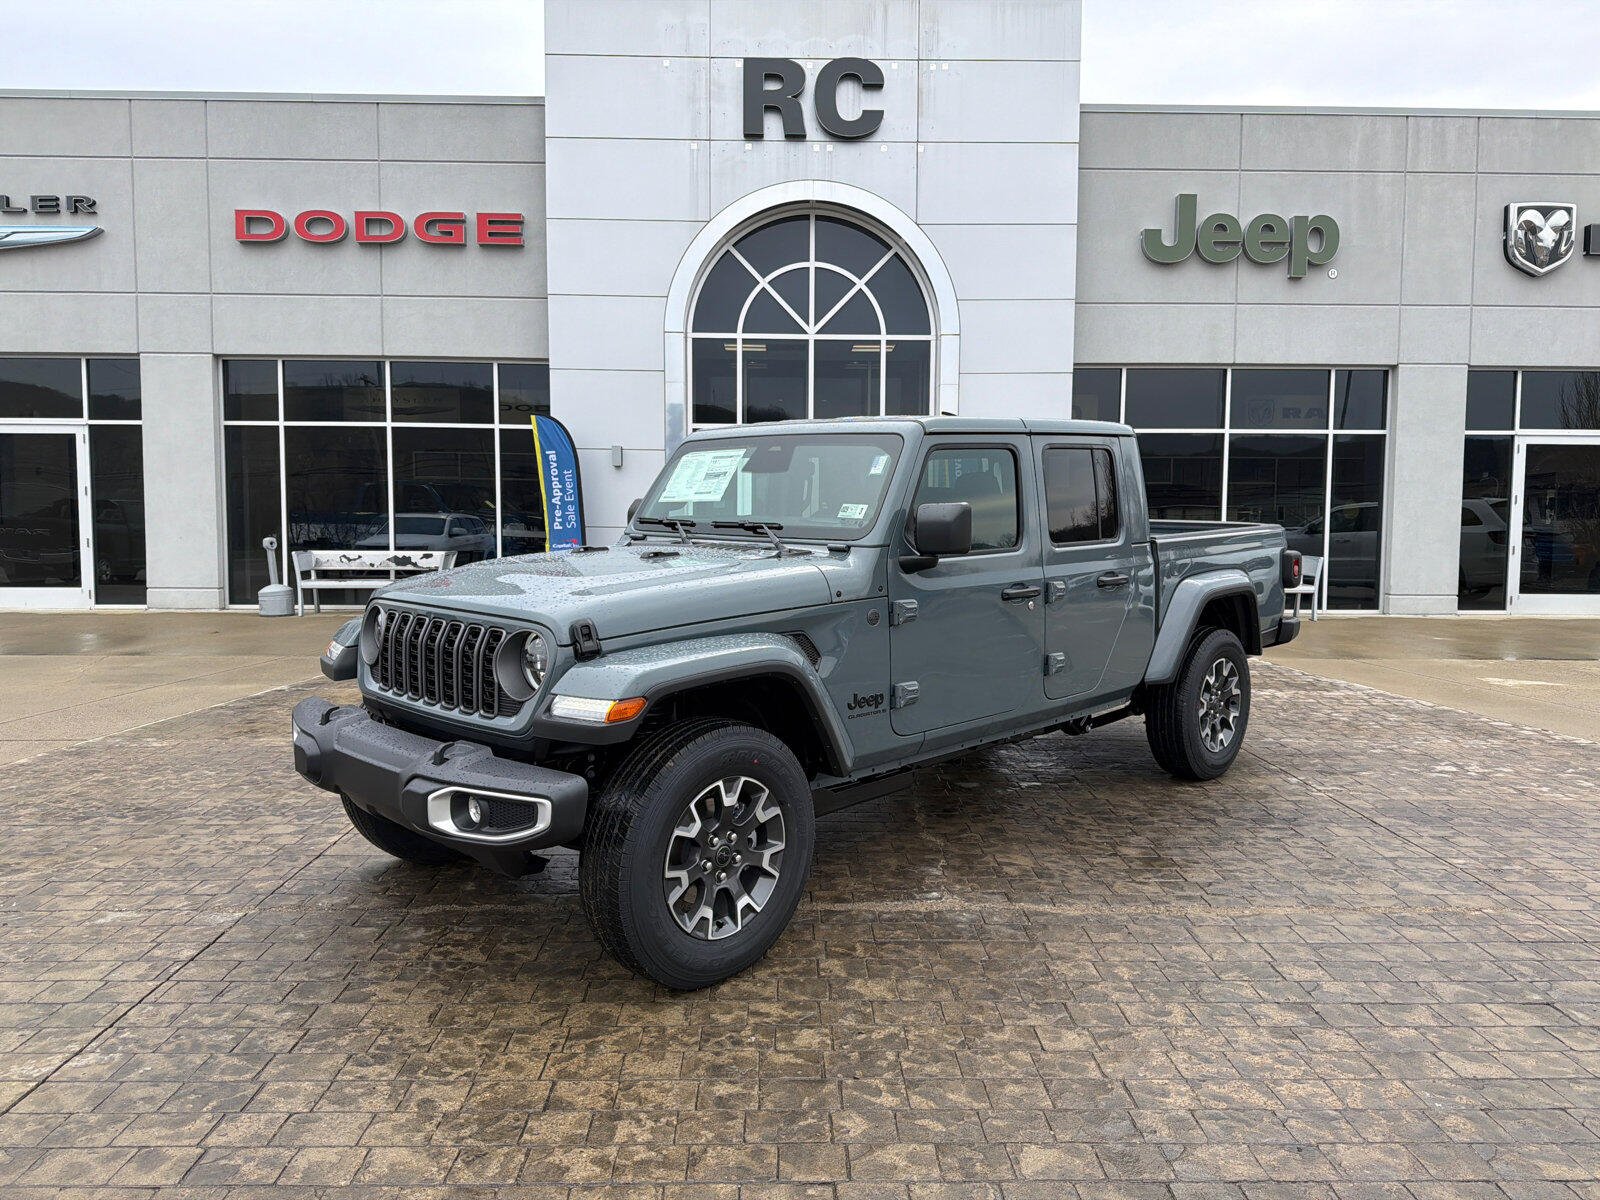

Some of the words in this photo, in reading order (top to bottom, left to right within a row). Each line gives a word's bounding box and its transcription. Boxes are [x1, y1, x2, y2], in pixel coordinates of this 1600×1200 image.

[743, 57, 885, 141] RC
[234, 208, 525, 247] DODGE
[1141, 193, 1340, 279] Jeep
[545, 450, 563, 530] Pre-Approval
[563, 469, 575, 501] Event
[565, 505, 577, 529] Sale
[847, 693, 884, 710] Jeep
